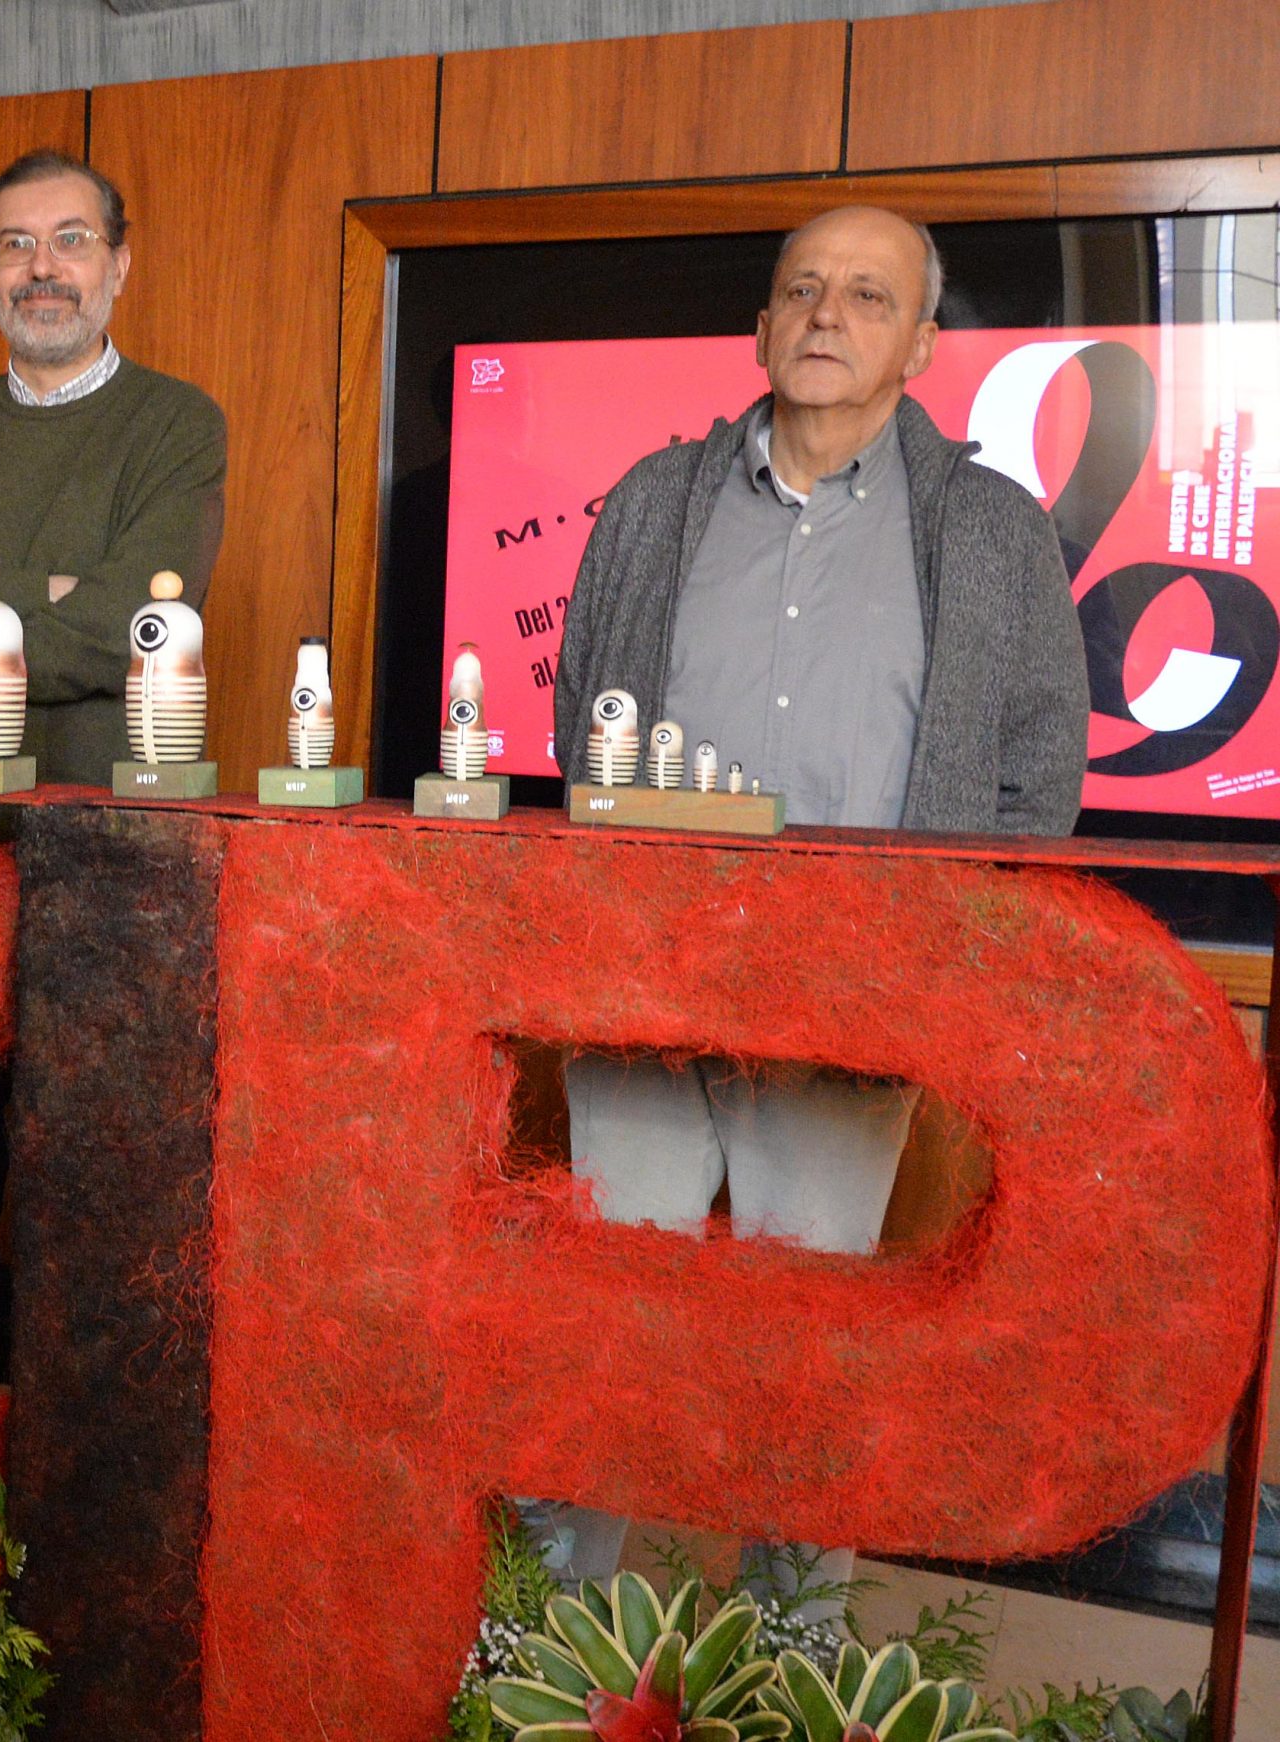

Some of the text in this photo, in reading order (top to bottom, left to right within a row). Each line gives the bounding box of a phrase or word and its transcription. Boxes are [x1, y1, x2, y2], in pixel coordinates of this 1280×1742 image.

[1168, 470, 1190, 553] MUESTRA
[1190, 484, 1212, 556] DE CINE
[1234, 541, 1253, 566] DE
[515, 602, 555, 639] Del
[531, 656, 554, 689] al
